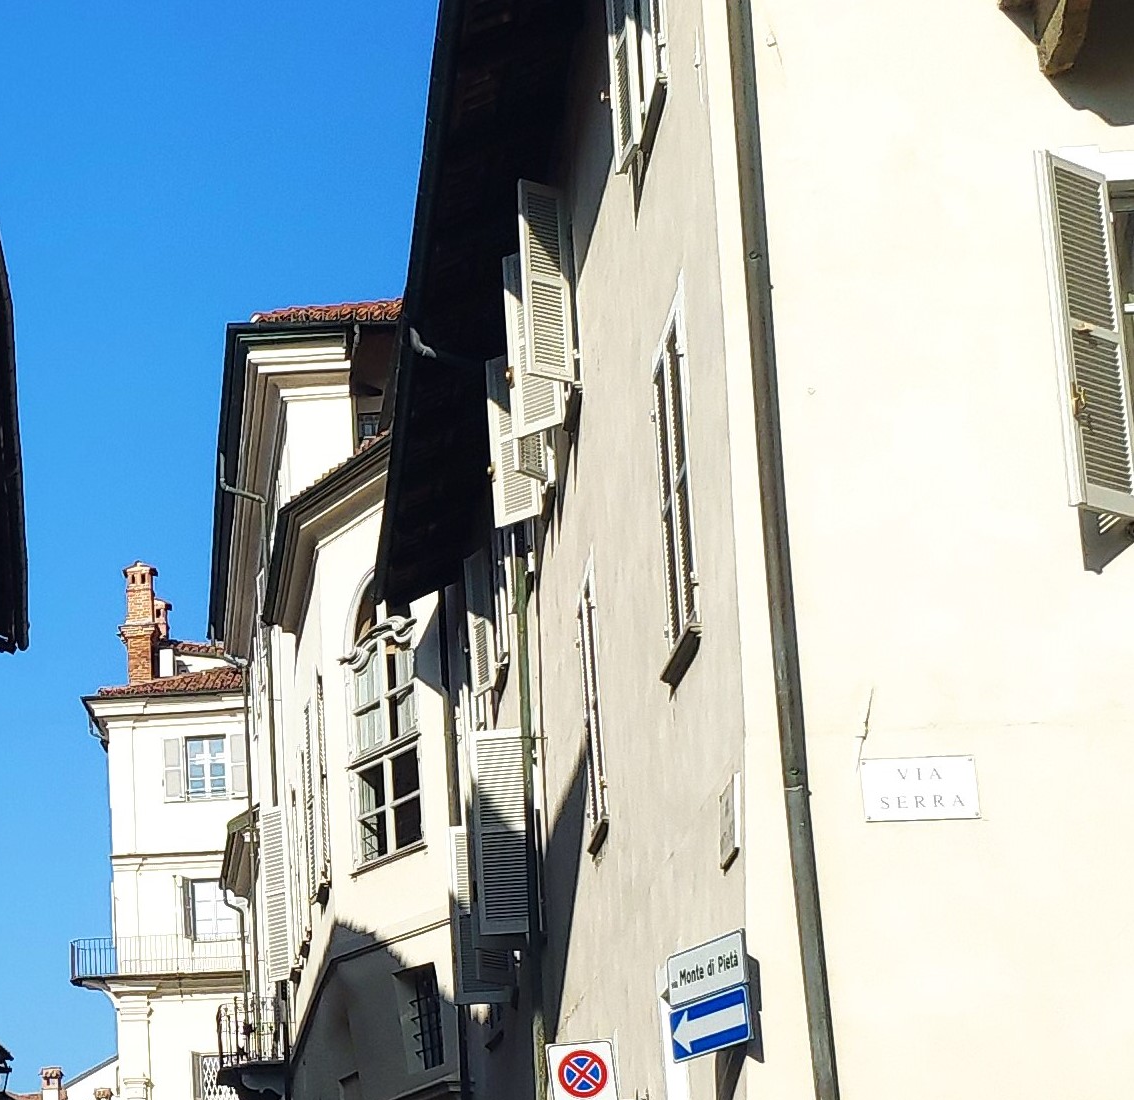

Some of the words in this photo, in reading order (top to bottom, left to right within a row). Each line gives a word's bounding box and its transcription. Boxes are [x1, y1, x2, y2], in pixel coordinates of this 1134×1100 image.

[897, 767, 942, 781] VIA
[880, 794, 965, 810] SERRA
[679, 964, 705, 987] Monte
[707, 958, 715, 976] di
[717, 950, 739, 973] Pietà
